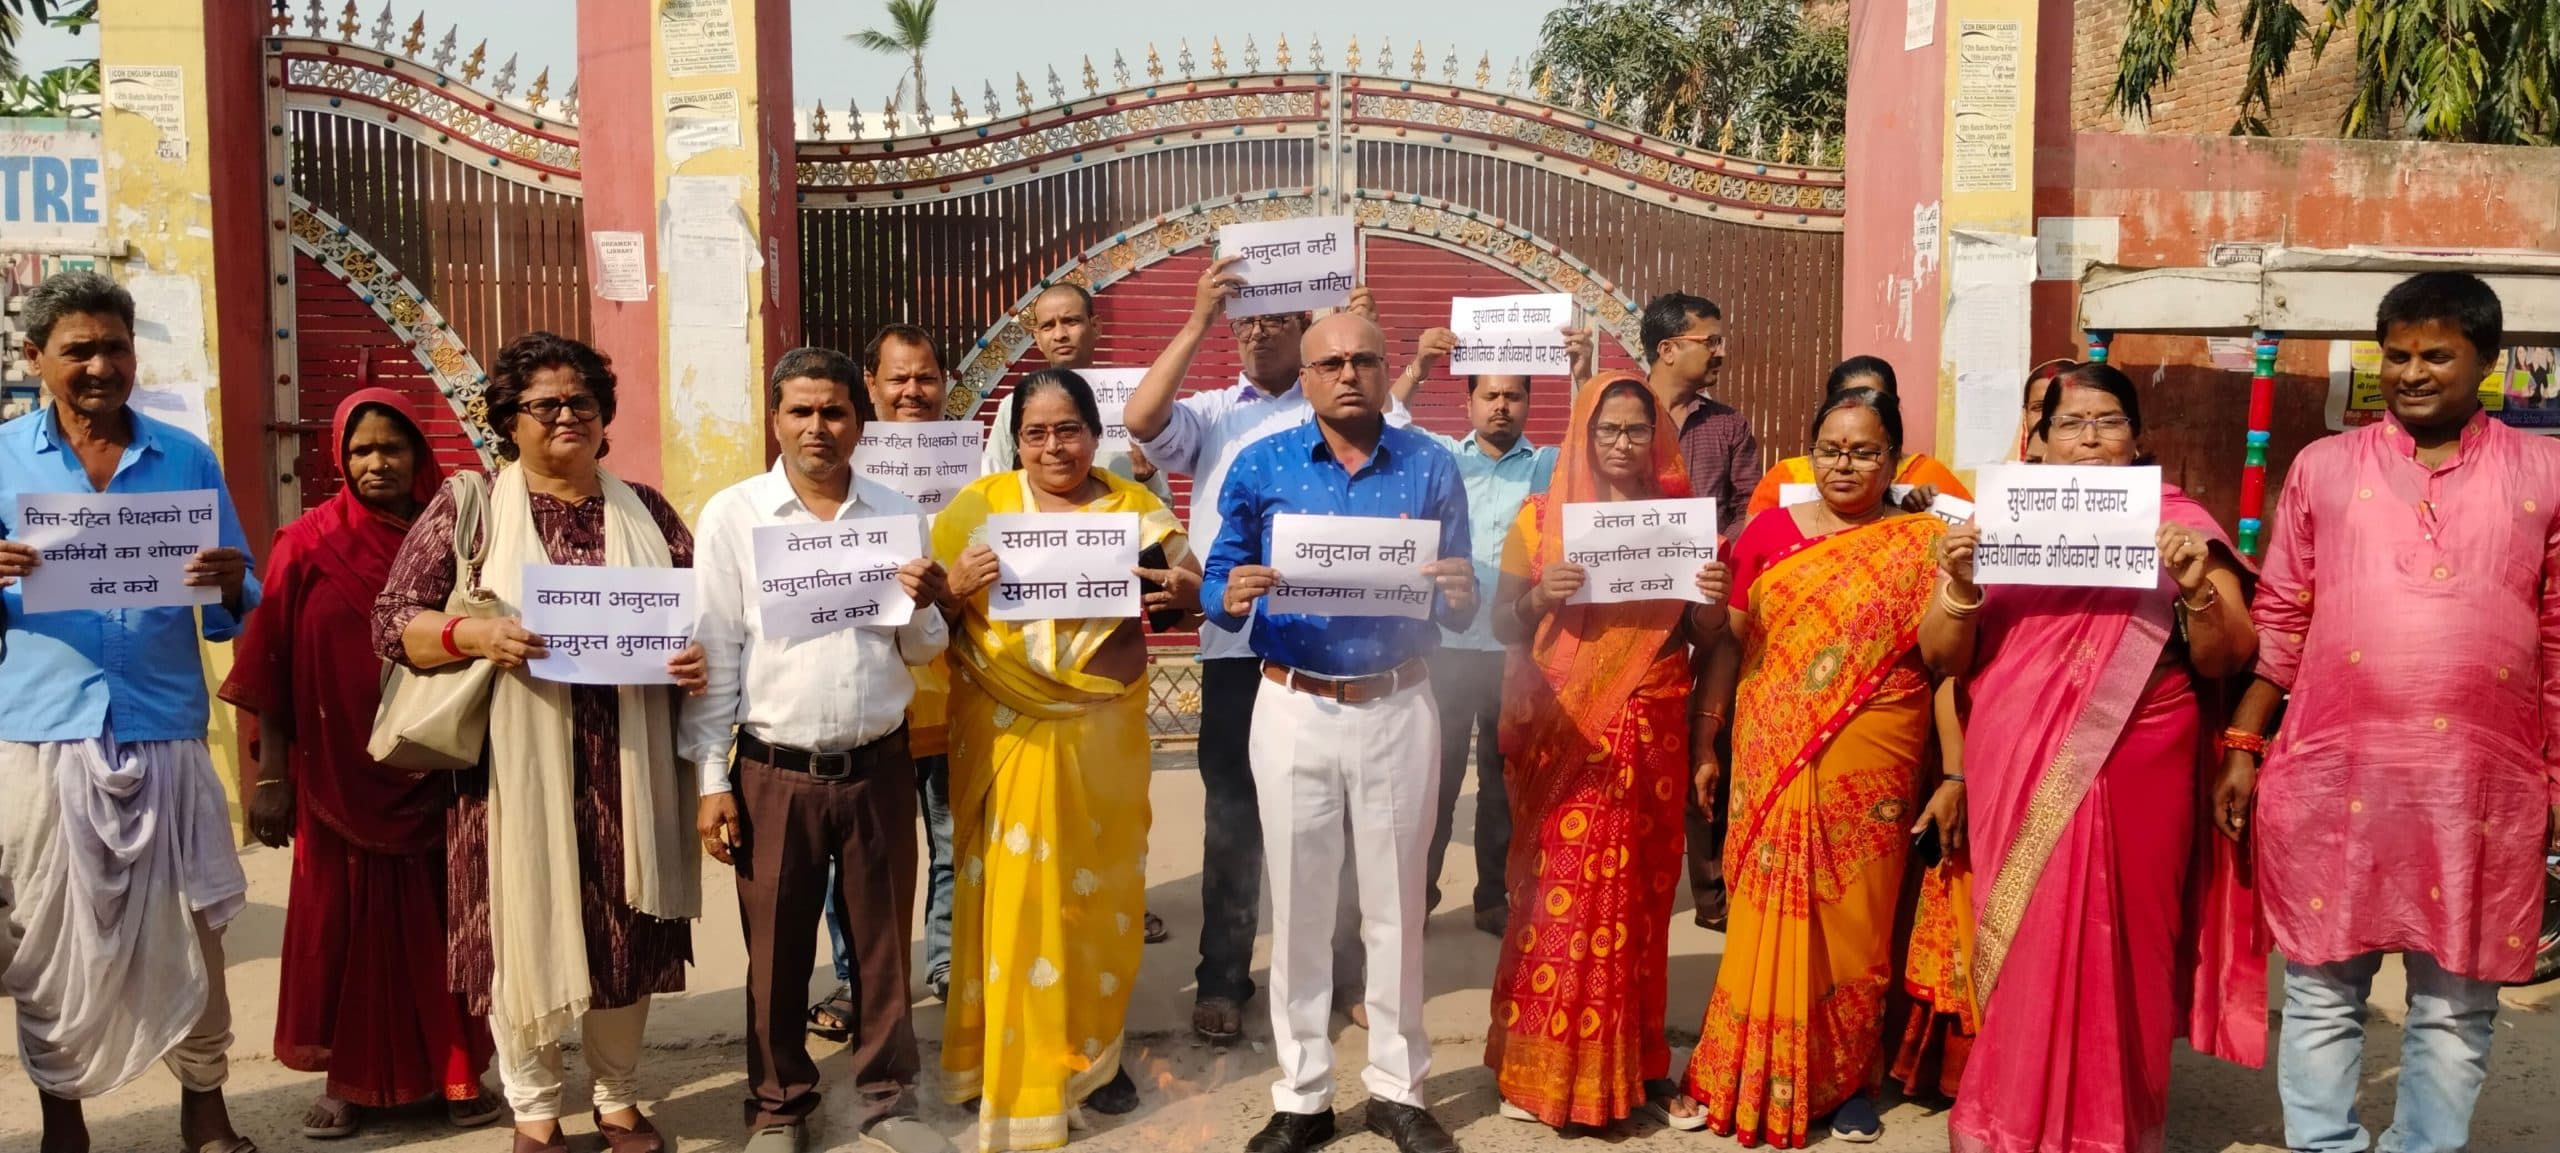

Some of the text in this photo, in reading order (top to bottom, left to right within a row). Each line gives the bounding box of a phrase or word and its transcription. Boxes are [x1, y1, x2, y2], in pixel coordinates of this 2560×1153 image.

[112, 70, 178, 78] ICON ENGLISH CLASSES
[670, 91, 733, 104] ICON ENGLISH CLASSES
[0, 155, 99, 223] TRE
[1240, 232, 1336, 264] अनुदान नहीं
[1308, 272, 1352, 292] चाहिए
[1472, 302, 1551, 330] सुशासन की सरकार
[1453, 337, 1568, 365] संवैधानिक अधिकारो पर प्रहार
[1096, 380, 1114, 403] और
[917, 432, 958, 448] शिक्षको
[962, 432, 979, 447] एवं
[866, 461, 968, 477] कर्मियों का शोषण
[917, 489, 941, 503] करो
[2008, 488, 2057, 522] सुशासन
[2062, 477, 2080, 511] की
[2084, 488, 2128, 513] सरकार
[25, 503, 213, 529] वित्त-रहित शिक्षको एवं
[1593, 508, 1687, 529] वेतन दो या
[43, 541, 200, 561] कर्मियों का शोषण
[787, 527, 888, 551] वेतन दो या
[1001, 529, 1126, 549] समान काम
[1295, 539, 1416, 567] अनुदान नहीं
[1569, 541, 1714, 568] अनुदानित कॉलेज
[1978, 533, 2156, 574] संवैधानिक अधिकारो पर प्रहार
[90, 575, 159, 595] बंद करो
[762, 561, 900, 597] अनुदानित कॉले
[1000, 573, 1129, 601] समान वेतन
[1609, 574, 1674, 594] बंद करो
[537, 589, 680, 613] बकाया अनुदान
[1275, 579, 1428, 605] वेतनमान चाहिए
[810, 599, 880, 624] बंद करो
[540, 633, 689, 656] कमुस्त भुगतान
